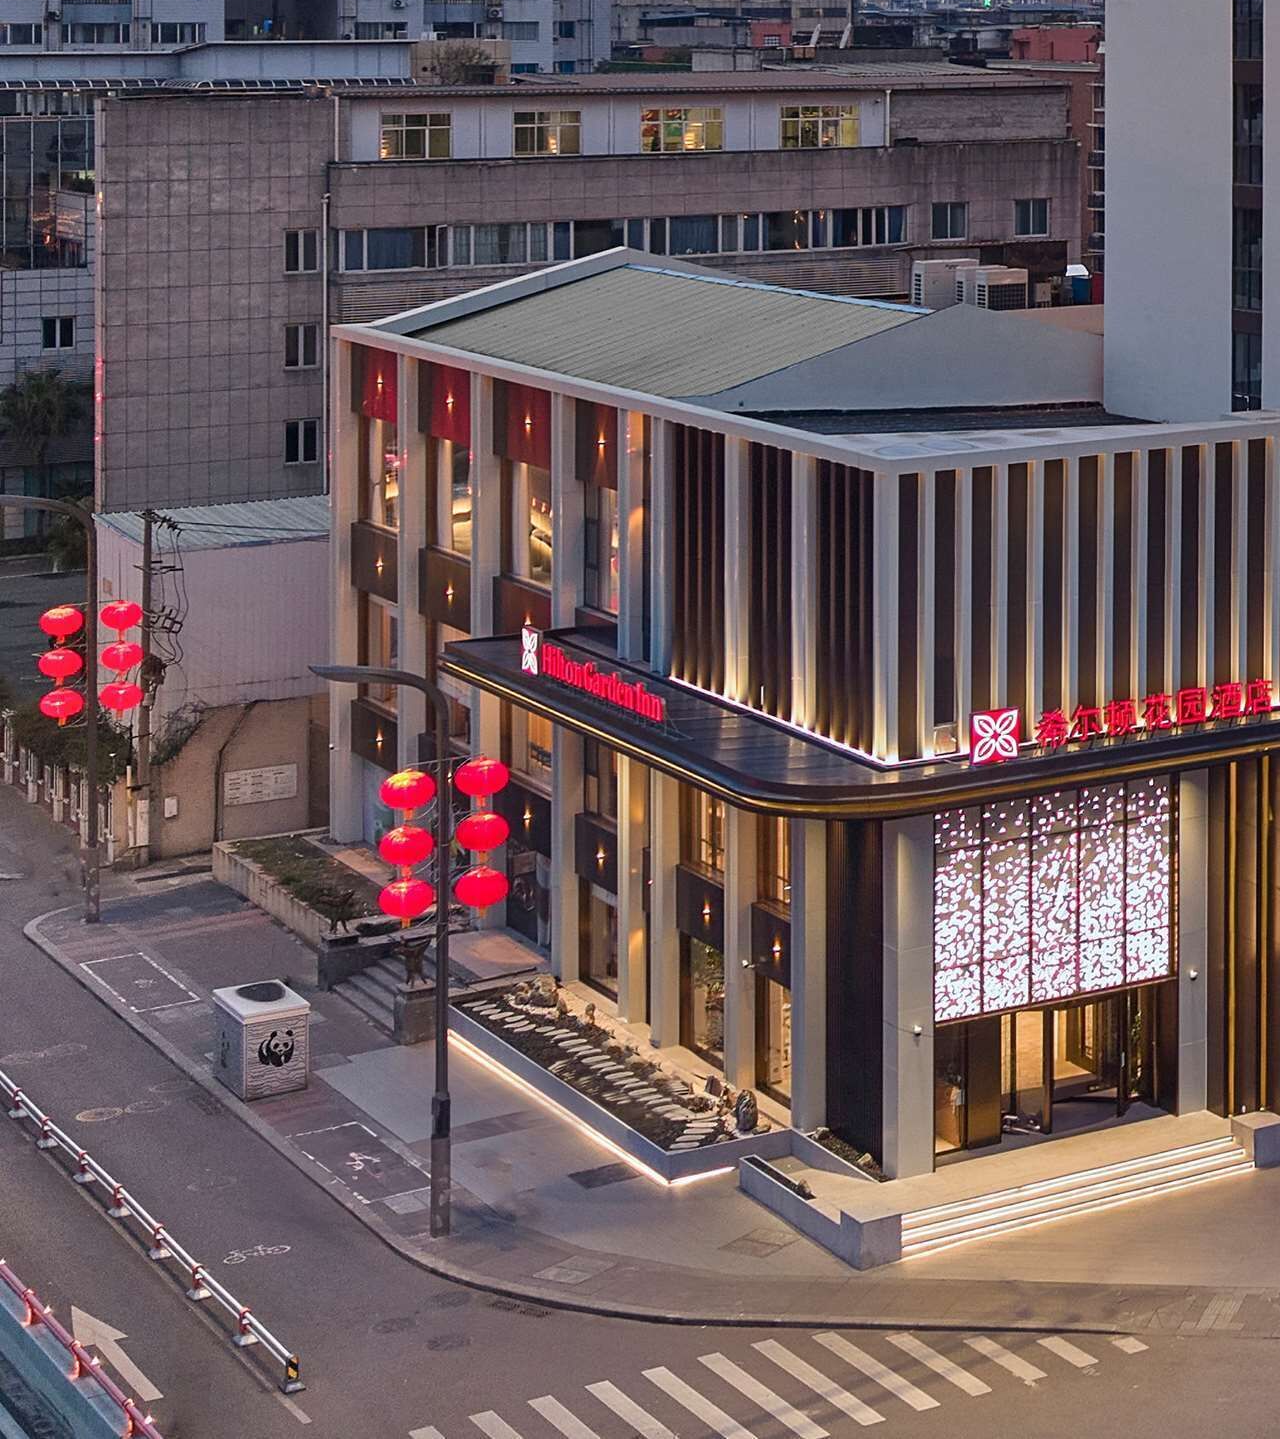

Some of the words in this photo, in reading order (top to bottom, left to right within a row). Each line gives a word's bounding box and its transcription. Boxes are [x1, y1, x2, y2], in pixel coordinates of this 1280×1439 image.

[541, 642, 583, 688] Hilton
[583, 661, 635, 710] Garden
[634, 681, 666, 723] Inn
[1034, 678, 1273, 747] 希尔顿花园酒店
